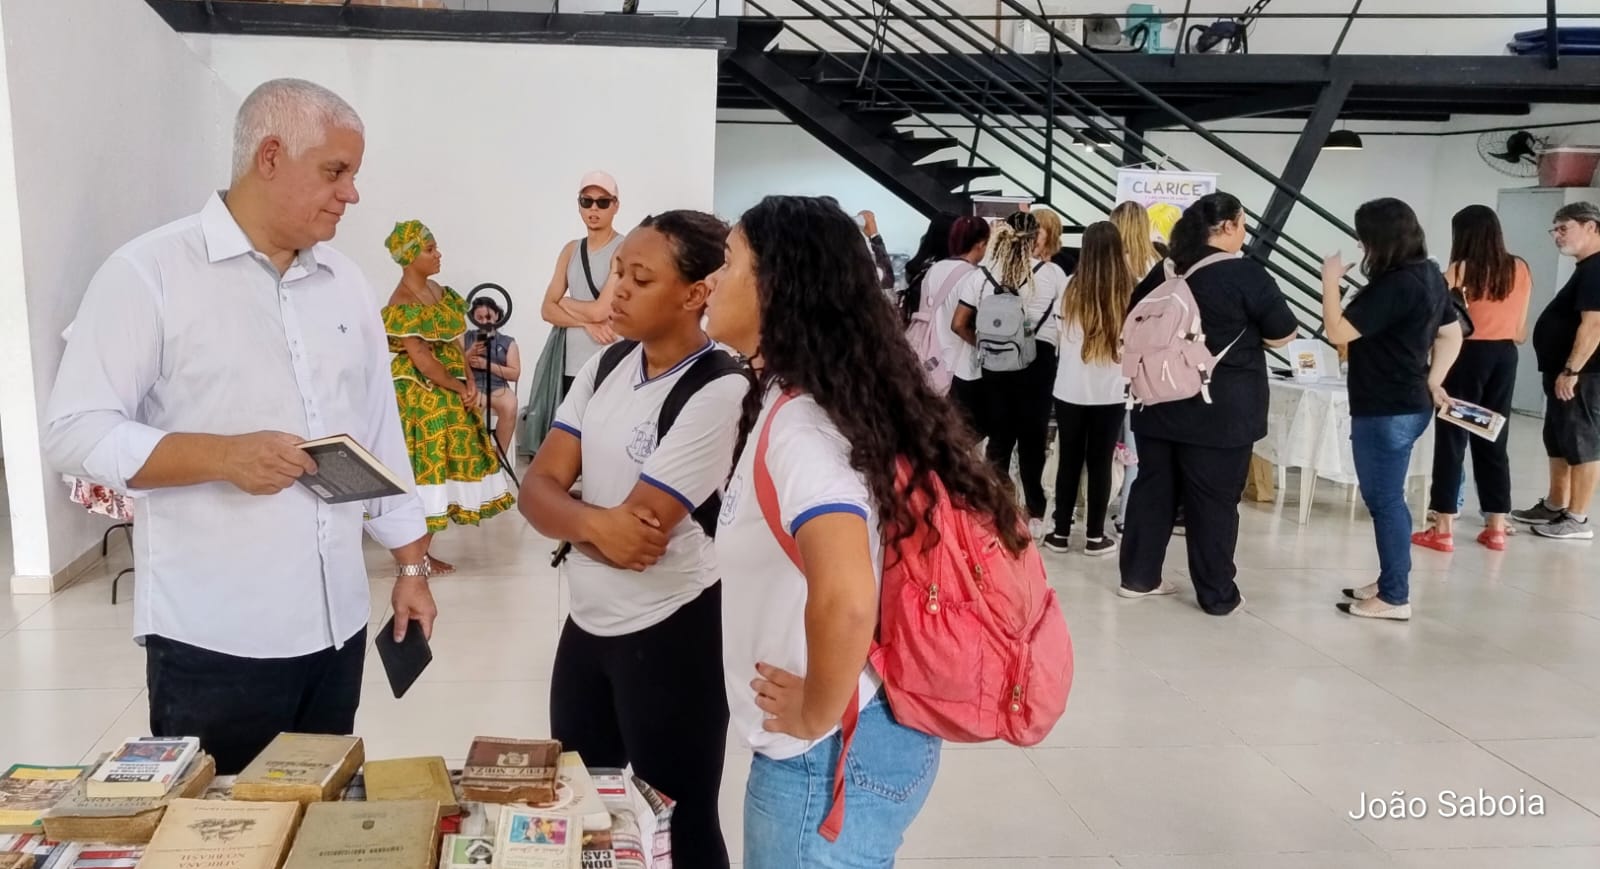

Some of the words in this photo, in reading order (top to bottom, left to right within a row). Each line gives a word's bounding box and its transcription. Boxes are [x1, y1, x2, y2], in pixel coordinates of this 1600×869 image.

[1132, 181, 1203, 196] CLARICE
[581, 851, 612, 860] CAS
[581, 860, 613, 869] DOM
